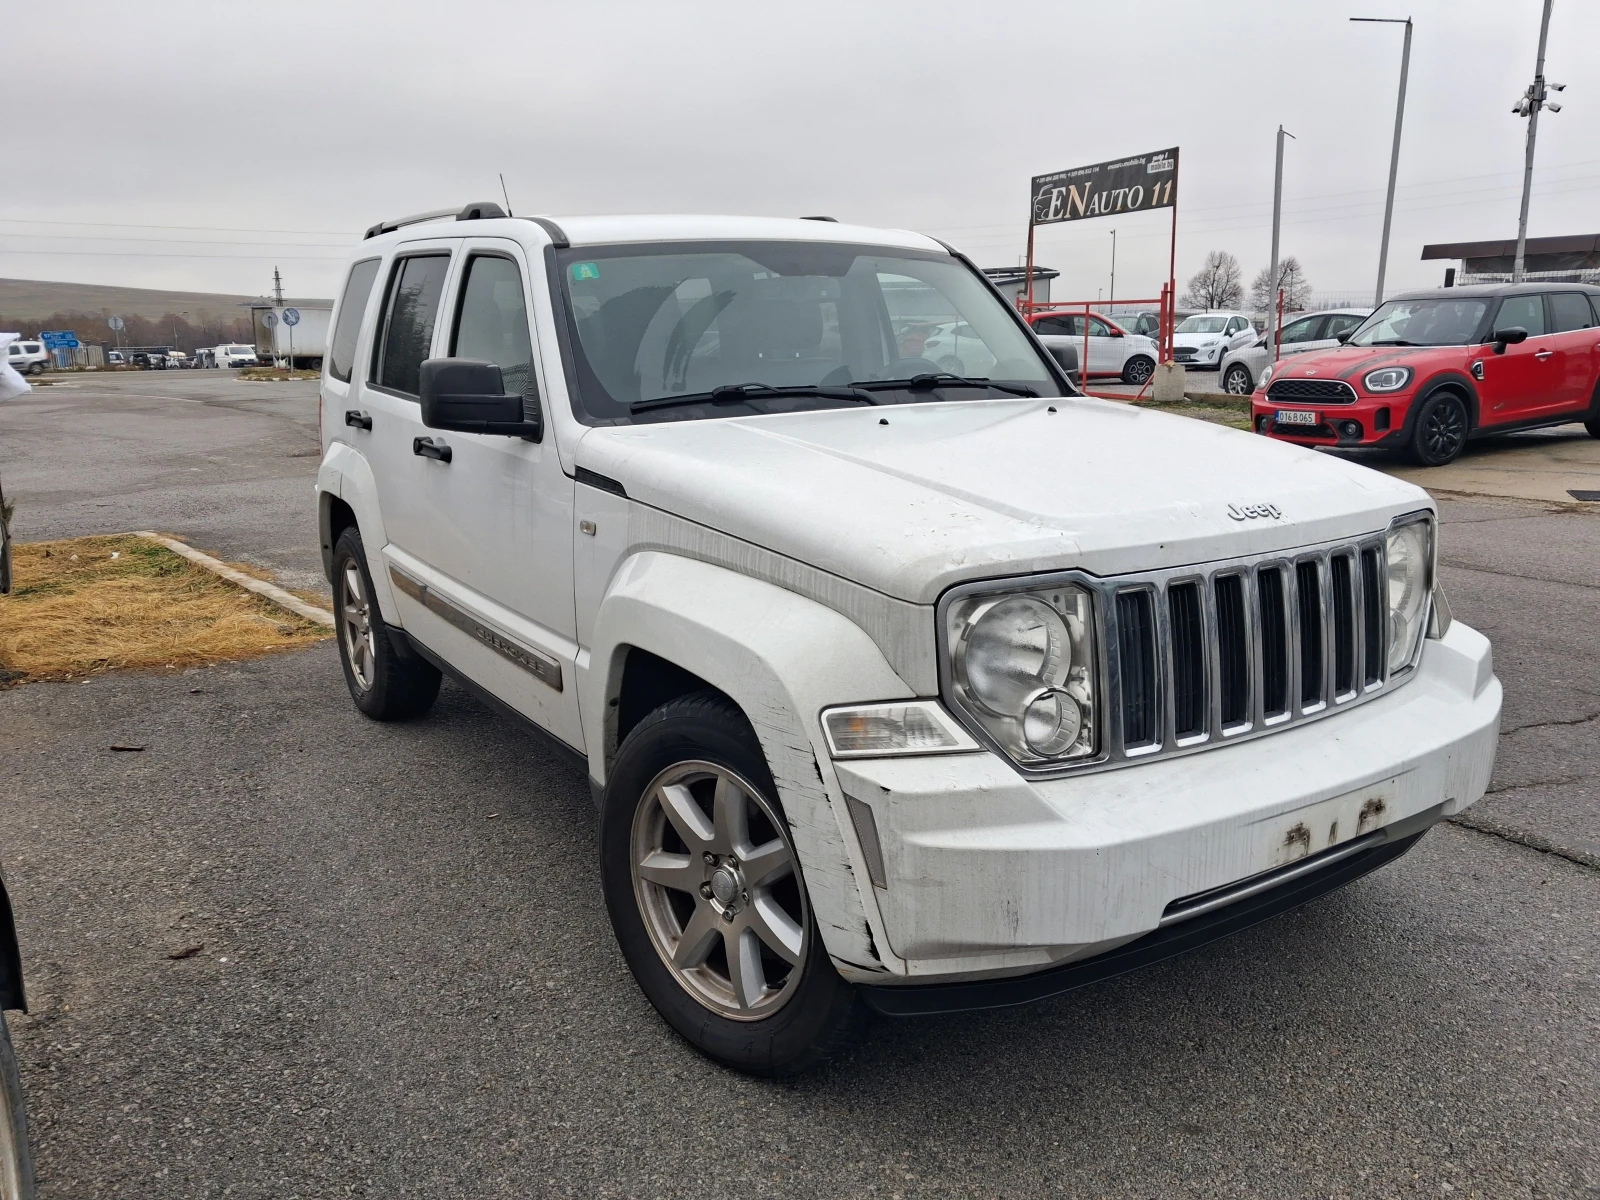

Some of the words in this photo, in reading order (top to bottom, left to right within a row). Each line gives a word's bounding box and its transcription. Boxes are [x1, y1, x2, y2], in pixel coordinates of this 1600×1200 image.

[1150, 160, 1173, 172] mobile.bg
[1152, 180, 1172, 206] 11
[1227, 502, 1282, 521] Jeep
[475, 627, 545, 675] CHEROKEE
